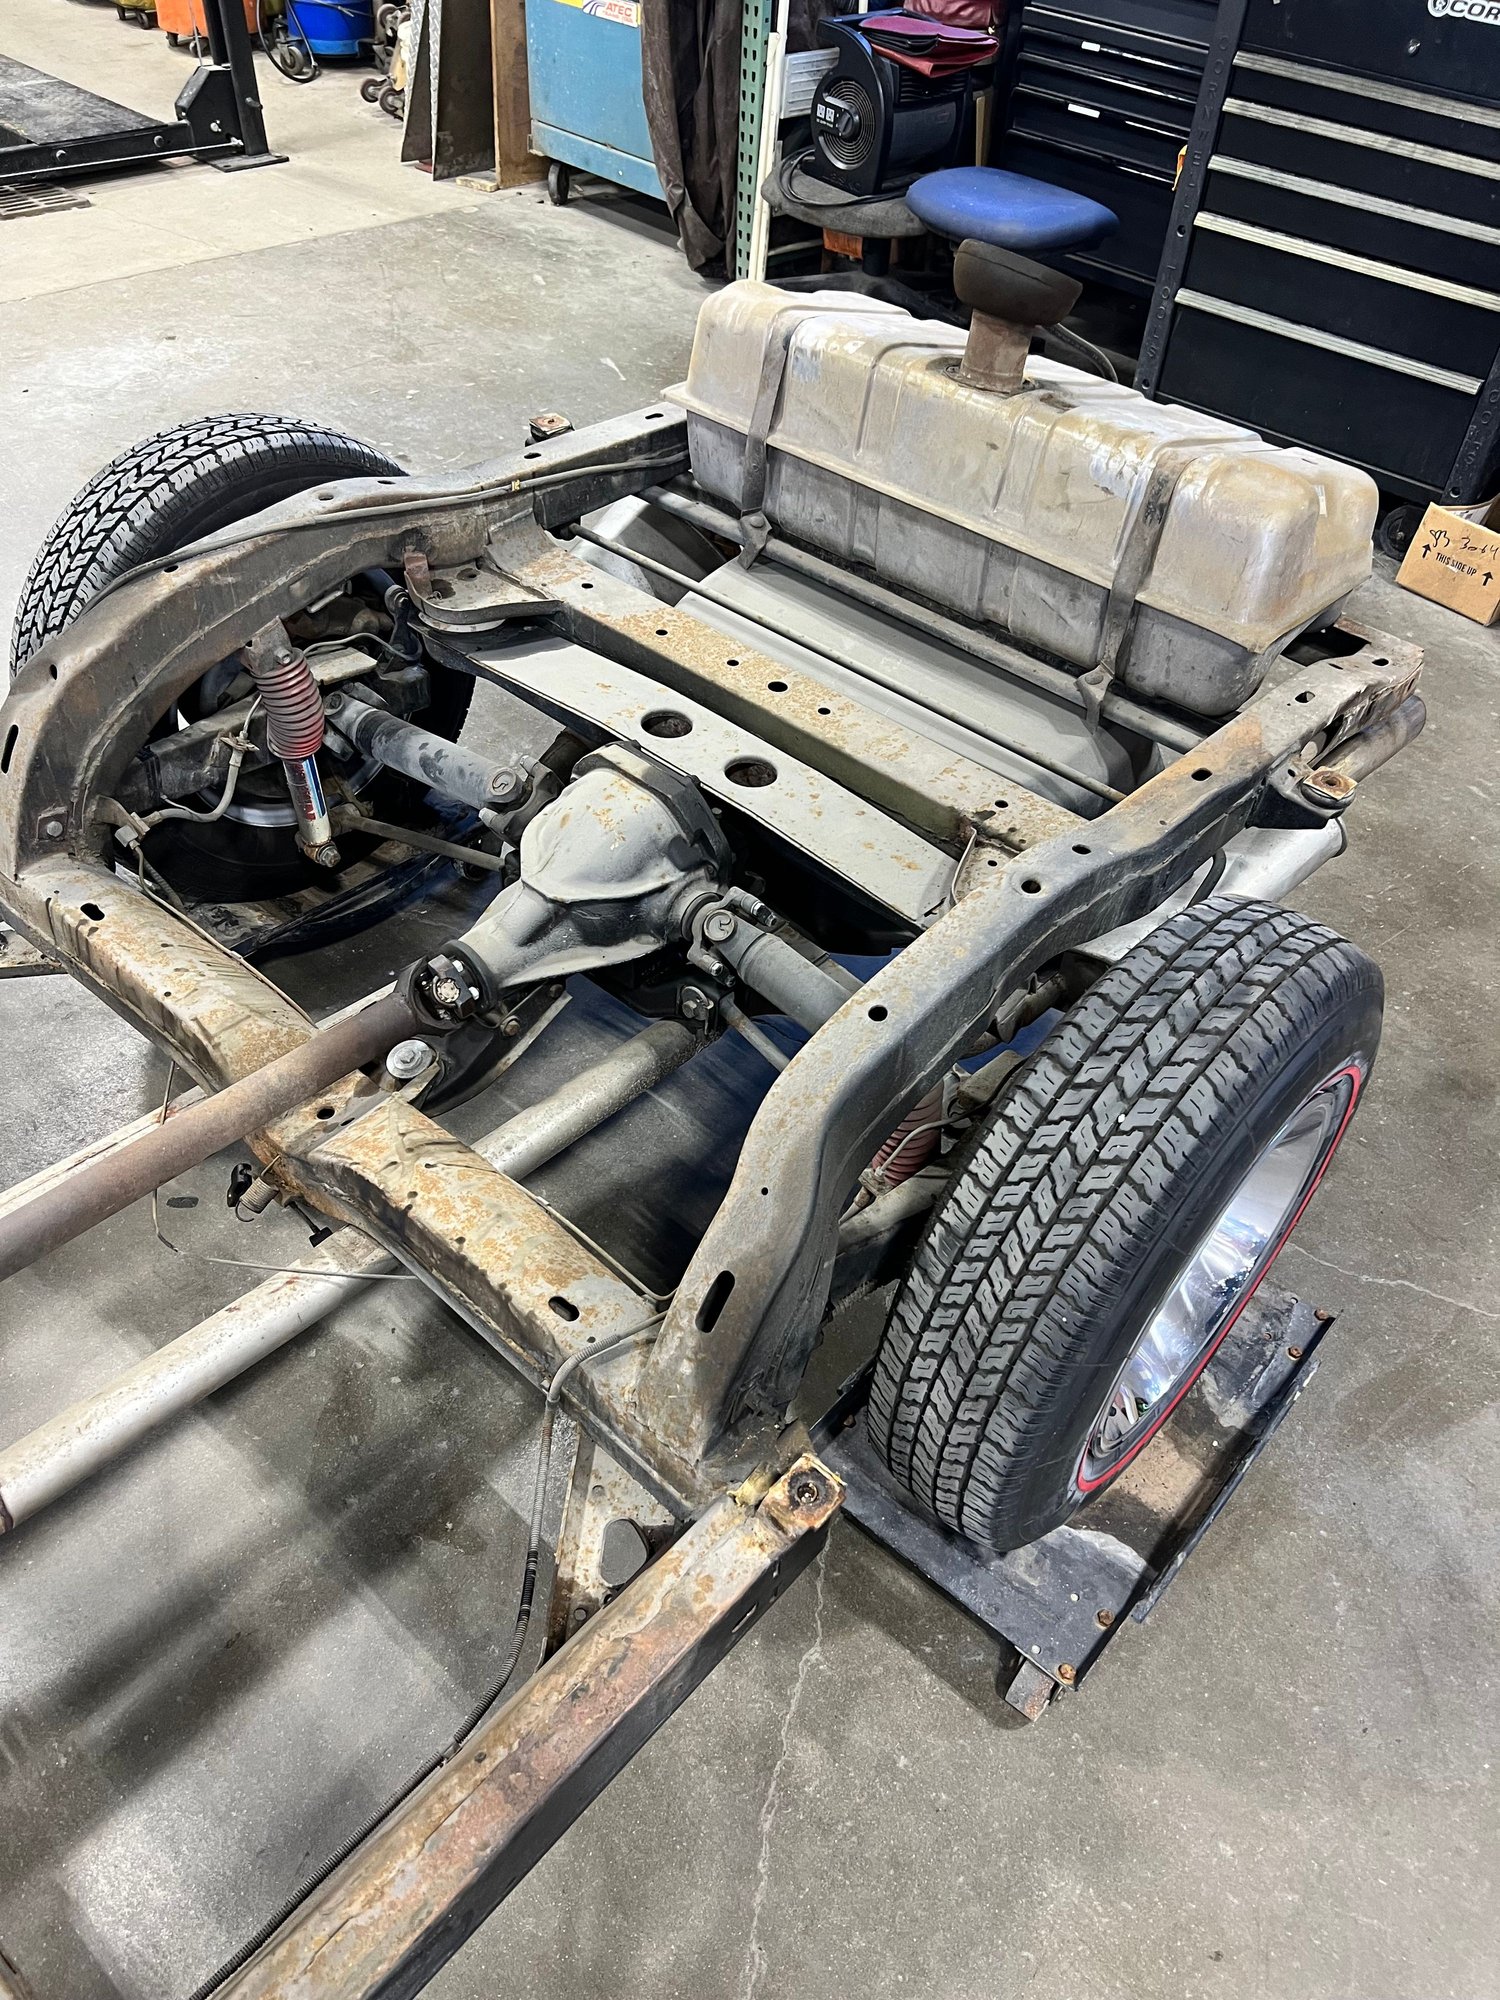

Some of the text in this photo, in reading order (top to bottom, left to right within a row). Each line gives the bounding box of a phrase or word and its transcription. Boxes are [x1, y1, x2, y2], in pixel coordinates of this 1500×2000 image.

[605, 2, 632, 17] ATEC
[1435, 552, 1477, 577] THIS SIDE UP
